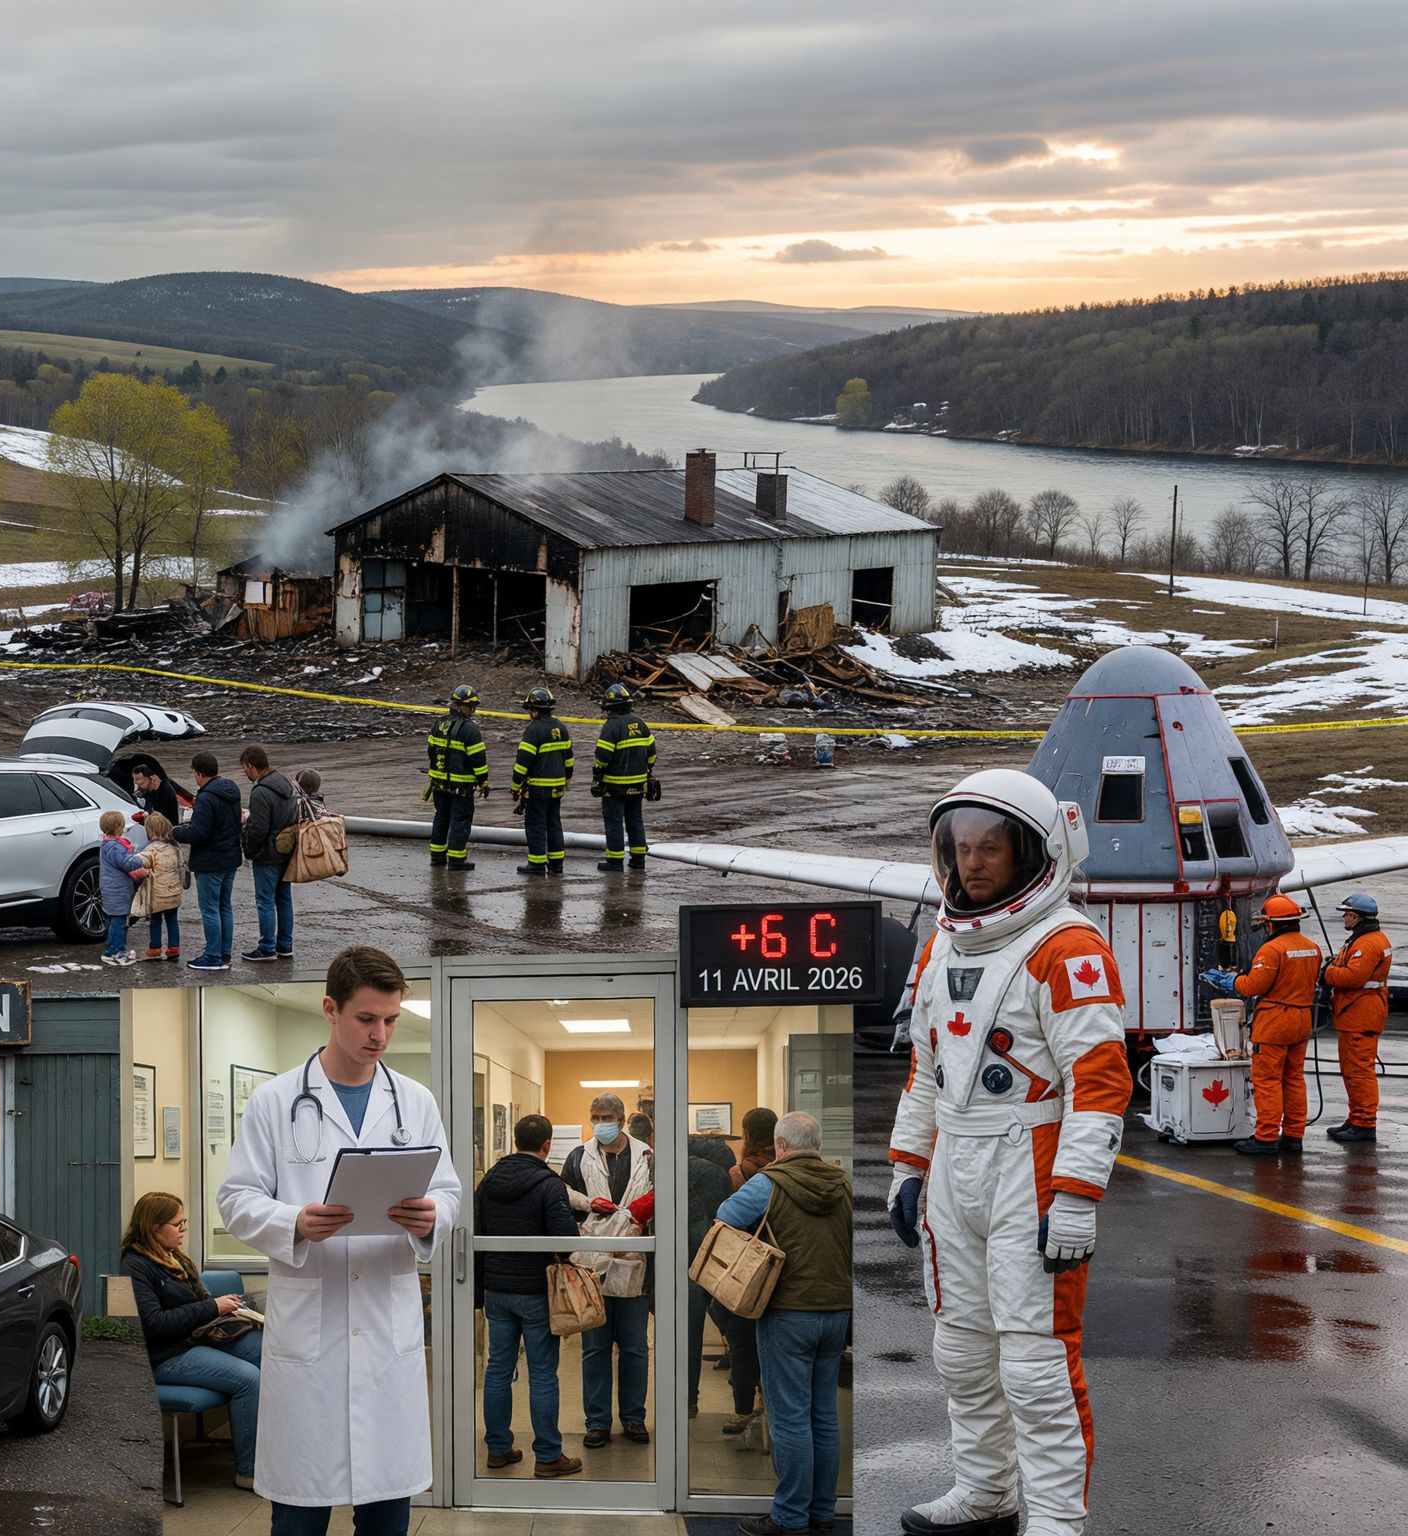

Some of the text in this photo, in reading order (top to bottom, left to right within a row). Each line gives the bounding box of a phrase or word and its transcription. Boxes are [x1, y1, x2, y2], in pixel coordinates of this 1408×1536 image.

[730, 913, 837, 959] +6 C
[698, 966, 863, 992] 11 AVRIL 2026
